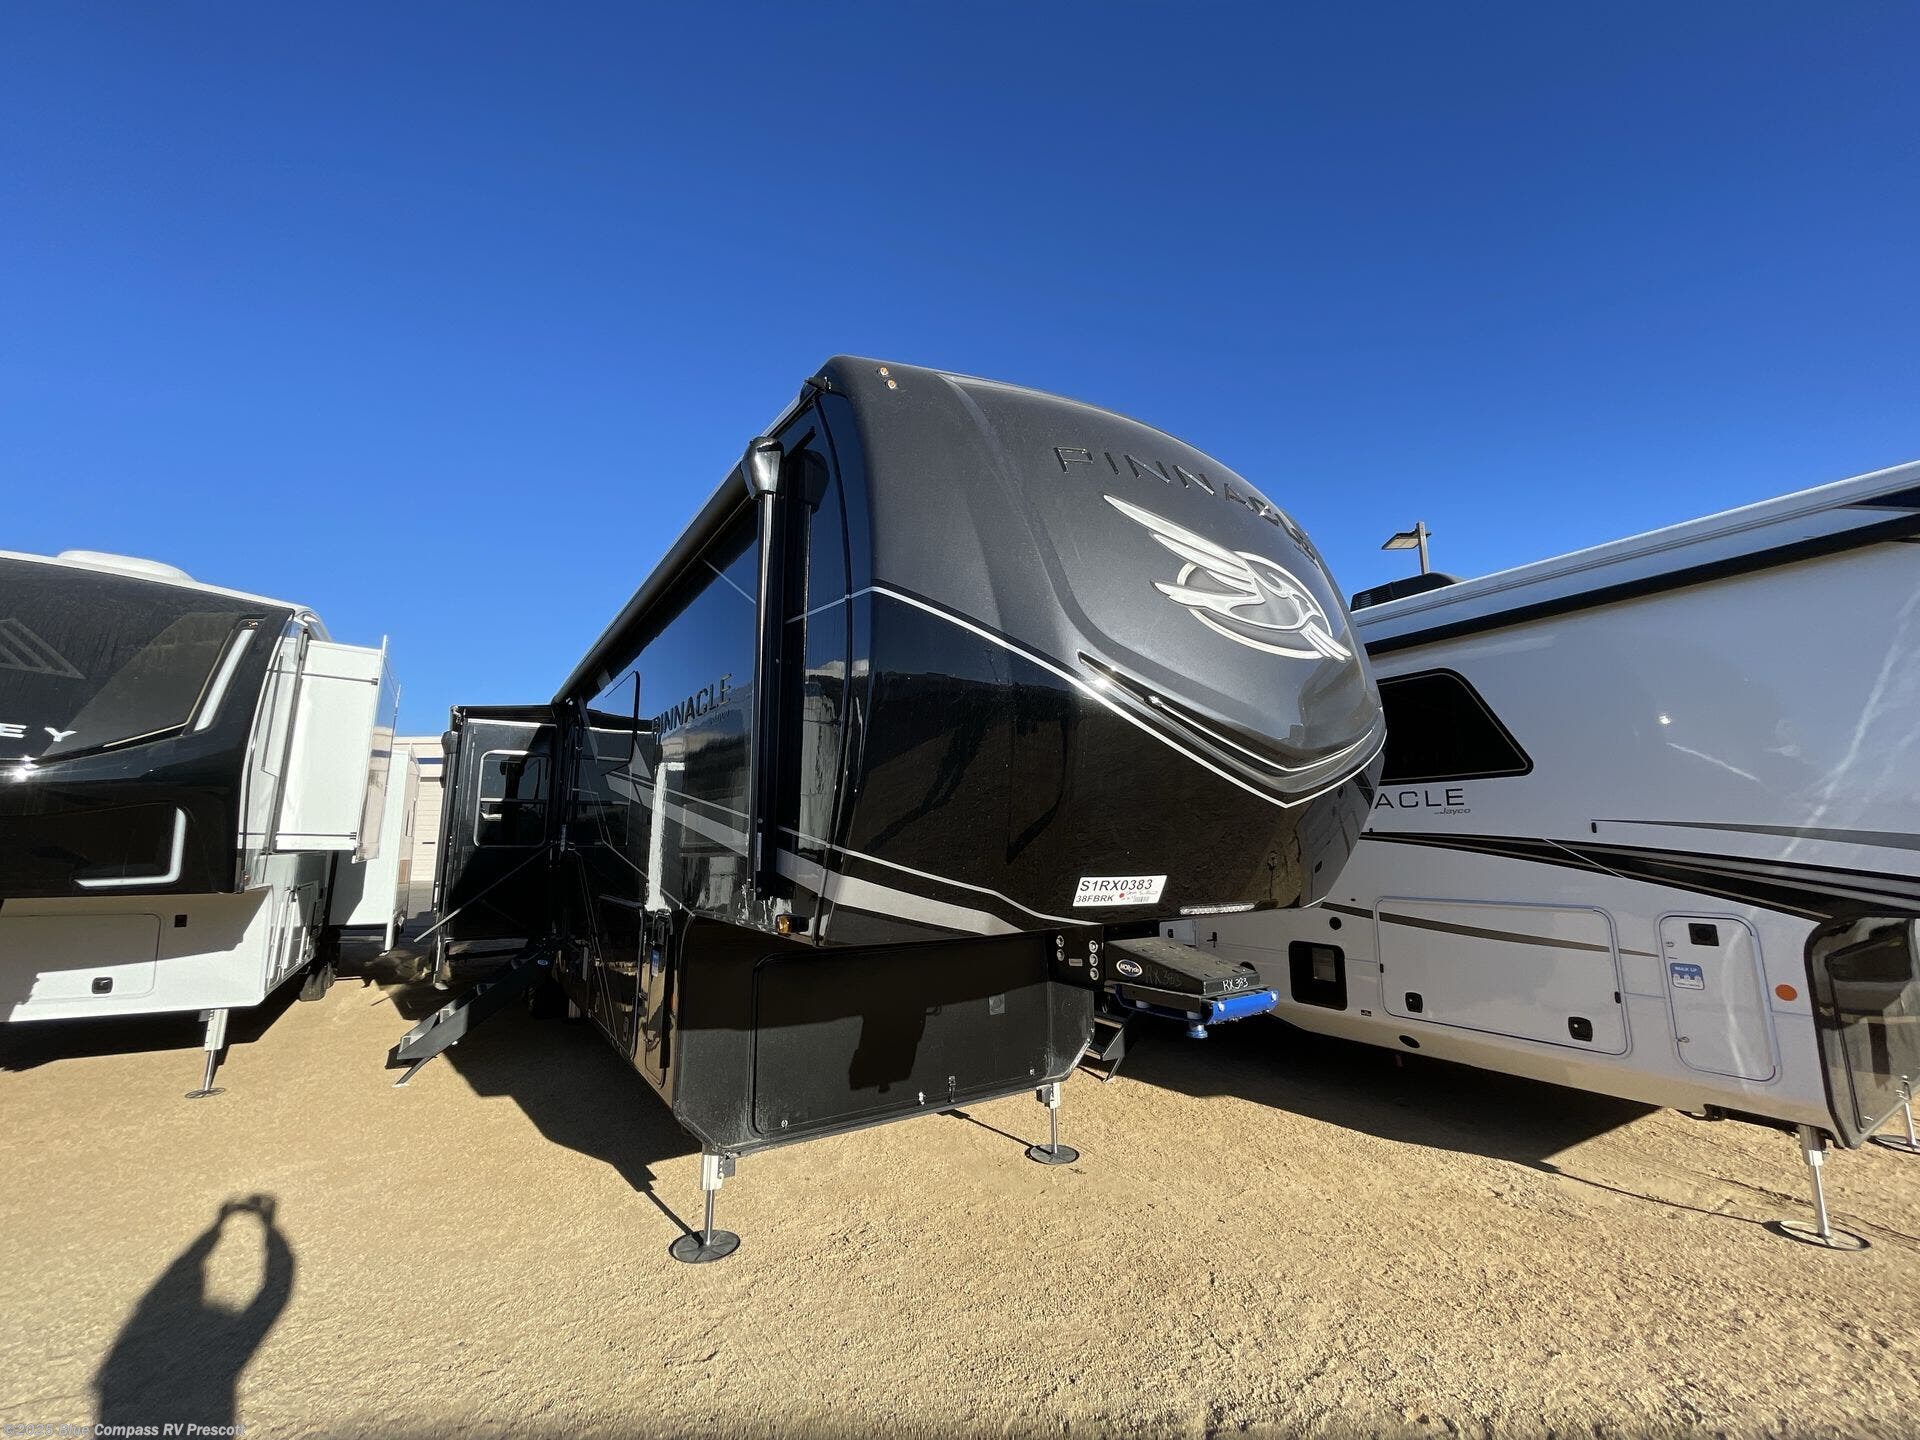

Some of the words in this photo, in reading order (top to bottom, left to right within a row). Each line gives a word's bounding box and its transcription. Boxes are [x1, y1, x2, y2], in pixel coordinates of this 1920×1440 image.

[652, 672, 733, 741] PINNACLE
[1439, 807, 1471, 815] Jayco
[1080, 878, 1153, 892] S1RX0383
[1075, 894, 1115, 903] 38FBRK
